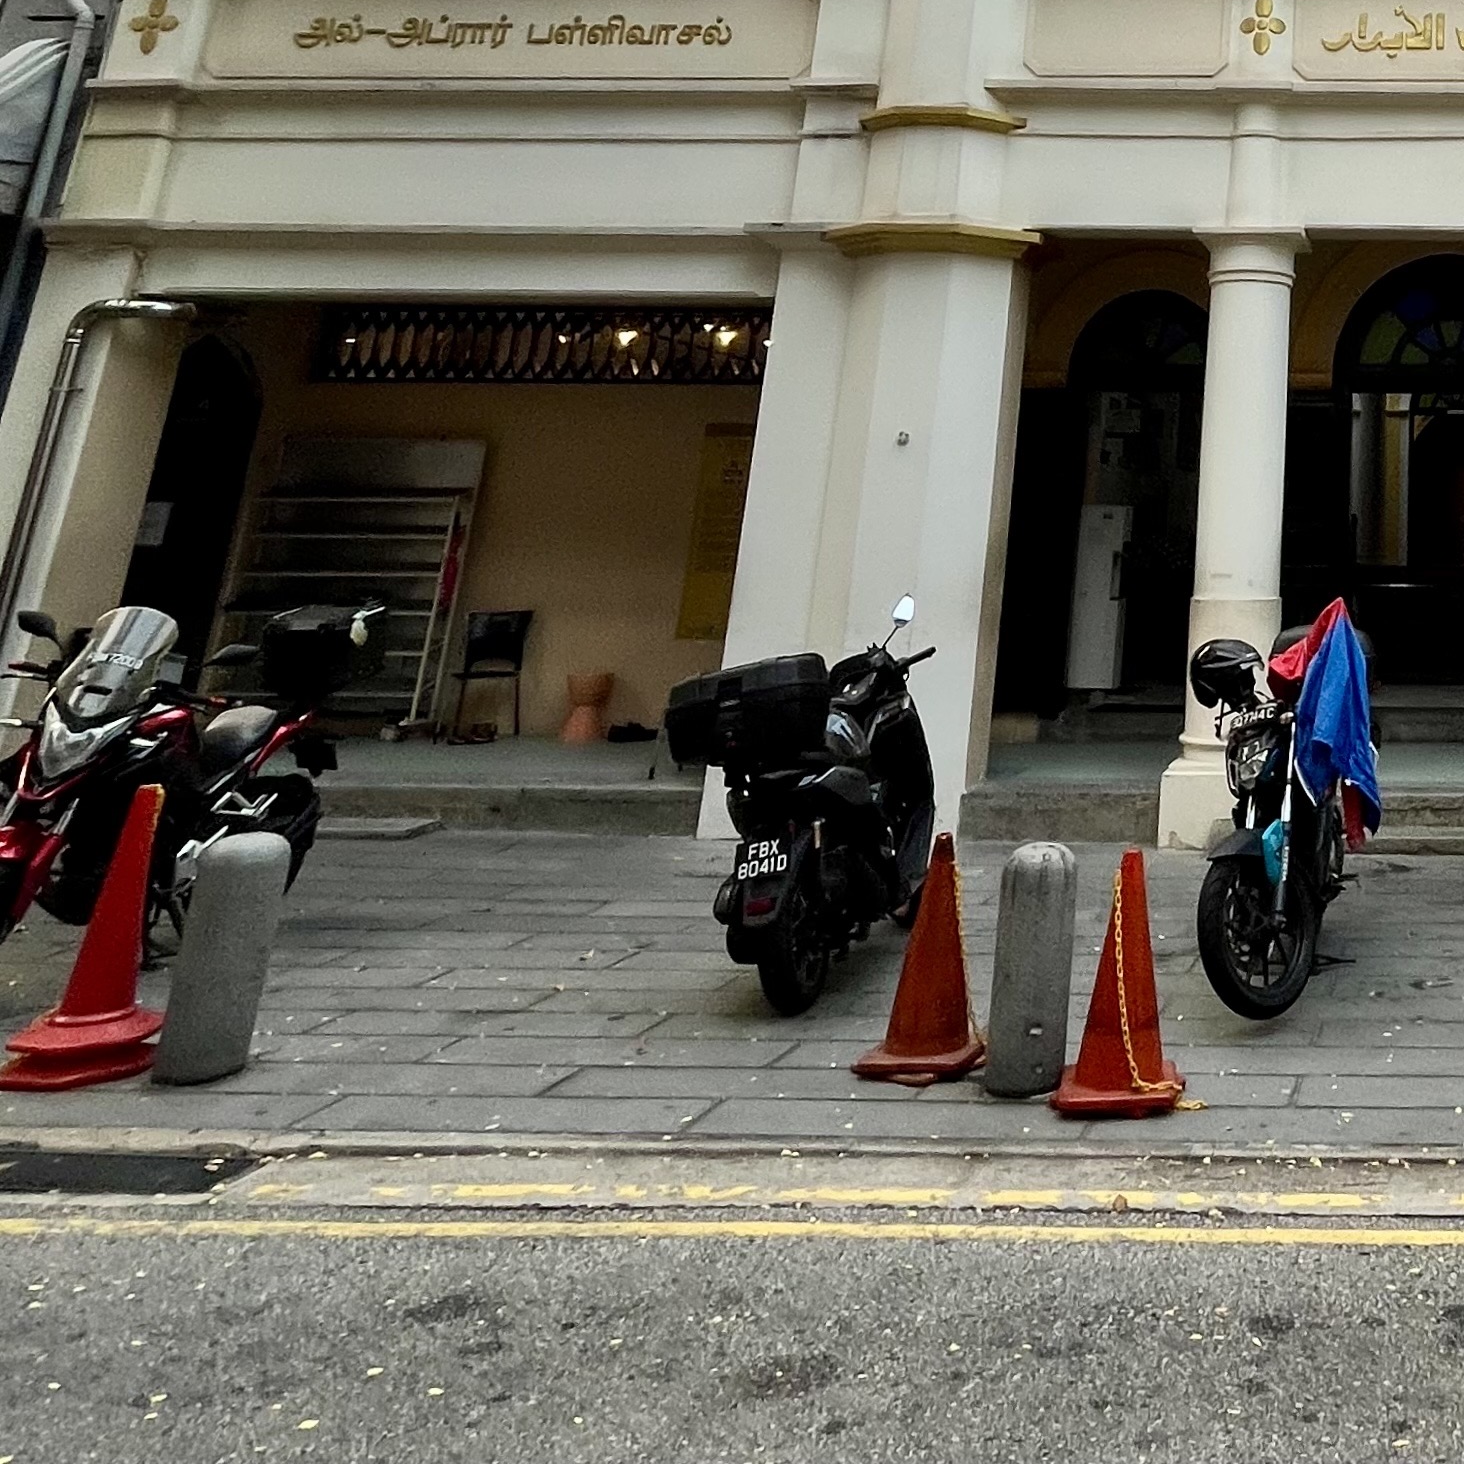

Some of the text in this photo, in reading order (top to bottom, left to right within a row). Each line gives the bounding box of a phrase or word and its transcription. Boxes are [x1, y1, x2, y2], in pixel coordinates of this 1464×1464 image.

[526, 14, 733, 47] பள்ளிவாசல்
[747, 838, 780, 861] FBX
[737, 854, 787, 880] 8041D
